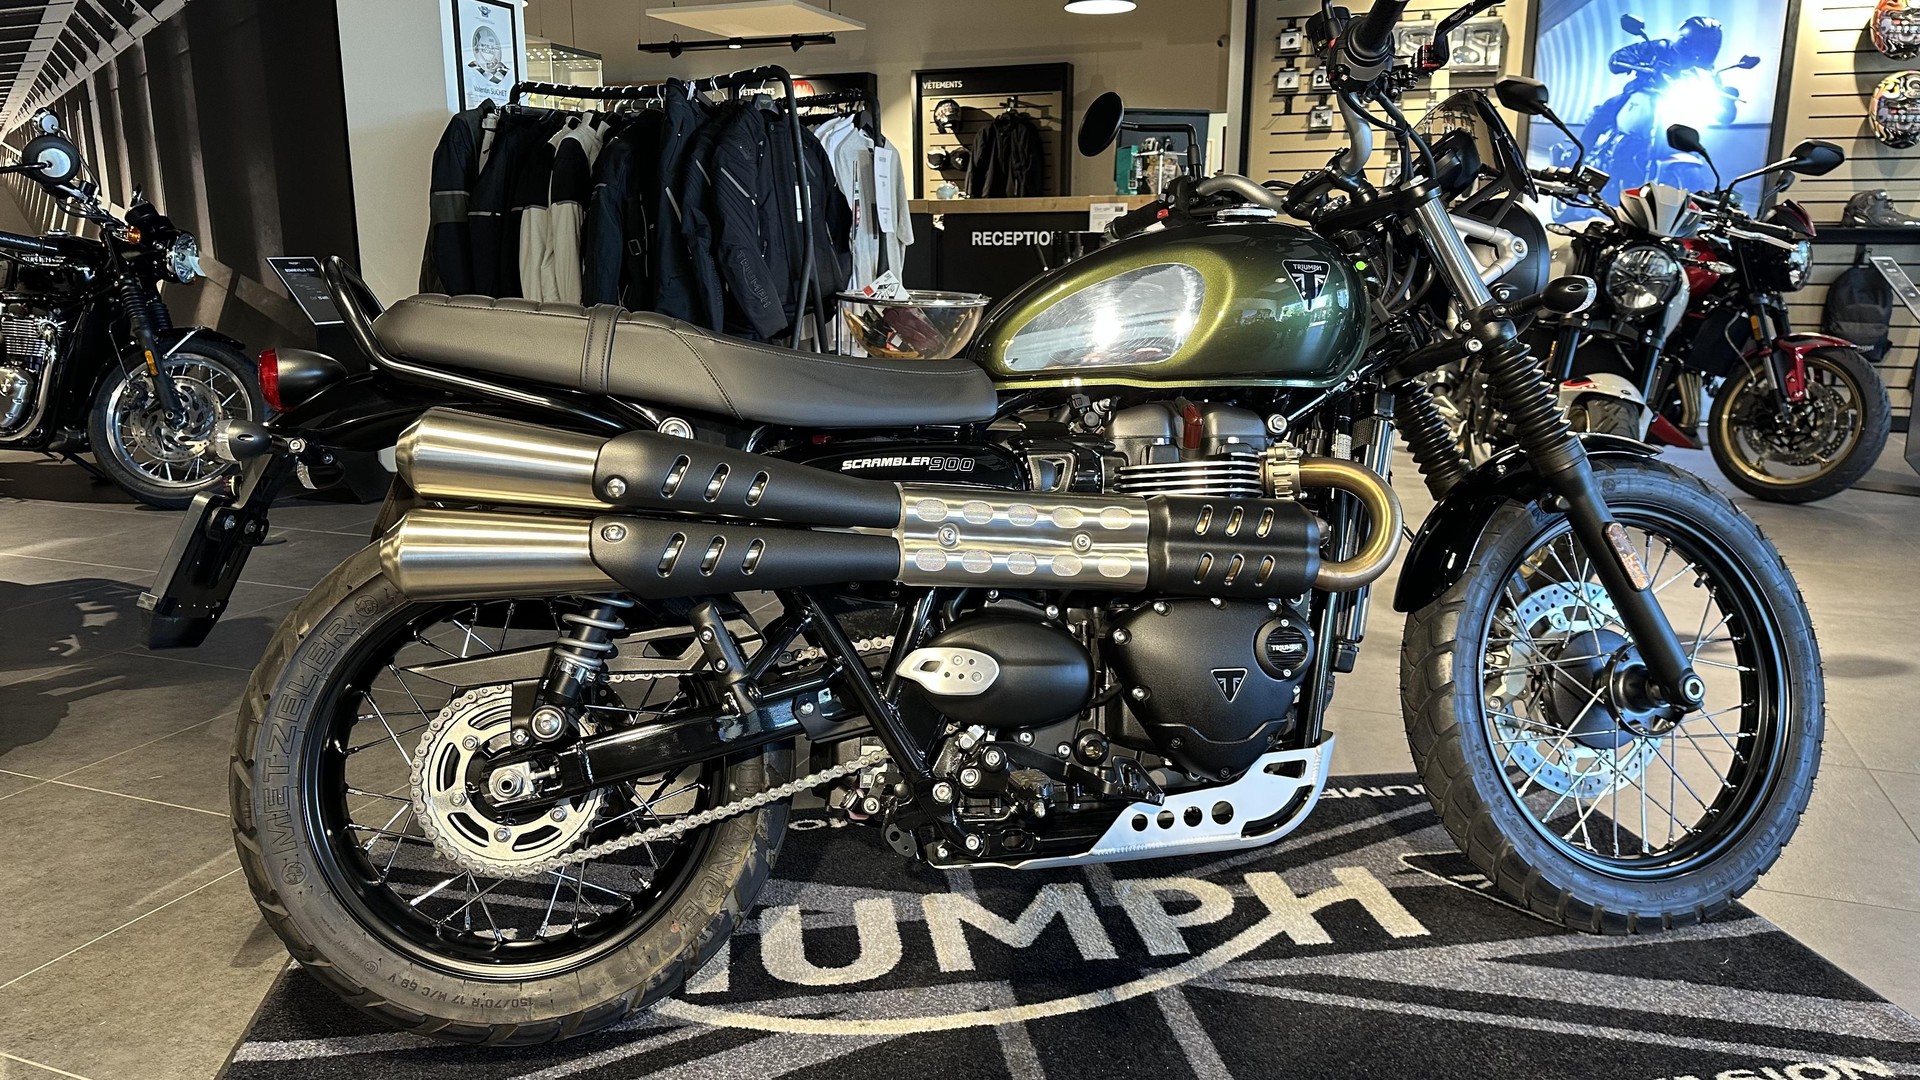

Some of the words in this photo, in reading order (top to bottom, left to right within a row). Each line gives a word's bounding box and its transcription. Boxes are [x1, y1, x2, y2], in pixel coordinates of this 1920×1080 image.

[922, 79, 963, 90] VÊTEMENTS
[971, 230, 1054, 246] RECEPTIO
[1292, 263, 1323, 273] TRIUMPH
[736, 249, 772, 309] TRIUMPH
[841, 456, 931, 471] SCRAMBLER
[929, 456, 976, 472] 900
[1270, 643, 1303, 653] TRIUMPH
[263, 616, 358, 855] METZELER
[420, 986, 448, 1002] M/C
[485, 997, 534, 1010] 150/70
